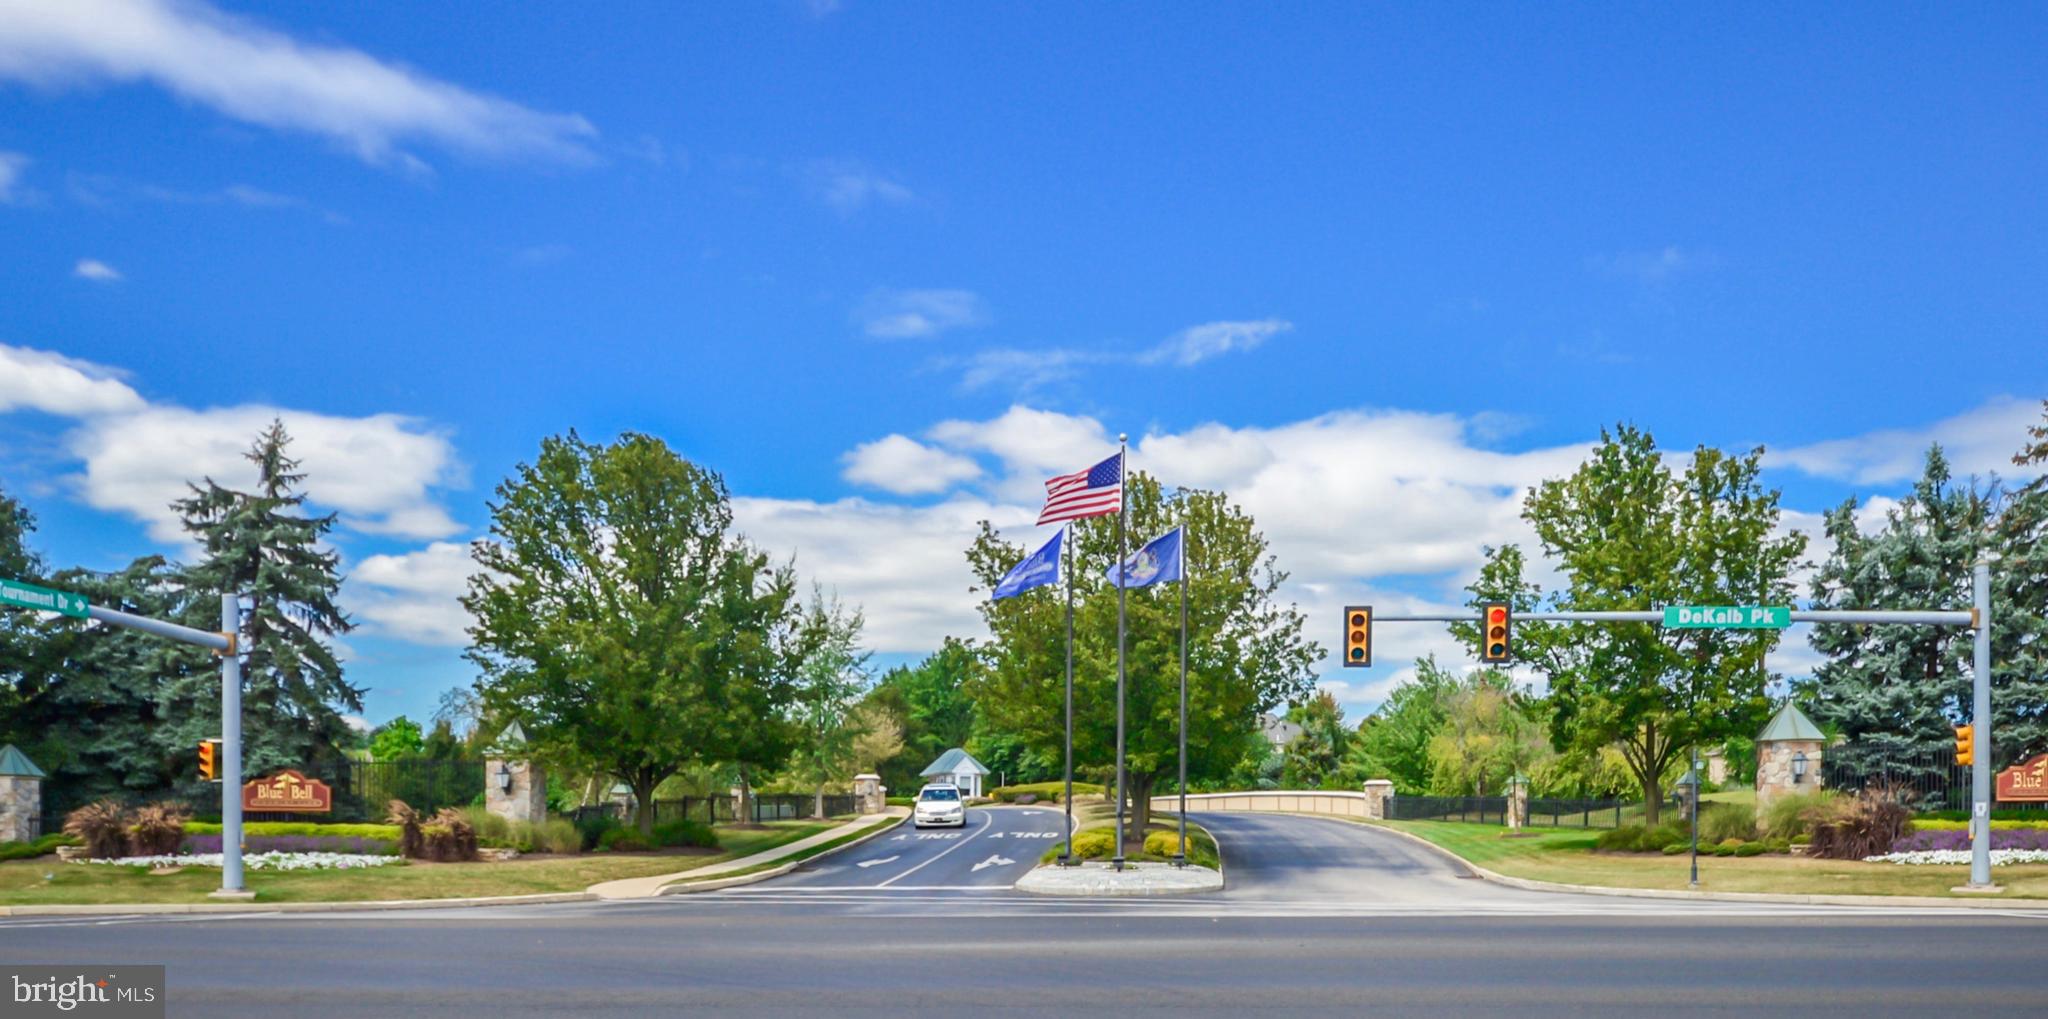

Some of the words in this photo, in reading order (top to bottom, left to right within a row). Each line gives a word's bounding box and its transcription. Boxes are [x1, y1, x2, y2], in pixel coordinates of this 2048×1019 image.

[0, 581, 54, 607] ournament
[57, 592, 68, 609] Dr
[1678, 608, 1743, 624] DeKalb
[1750, 608, 1774, 624] Pk
[2012, 771, 2042, 788] Blue
[257, 784, 283, 799] Blue
[291, 784, 313, 799] Bell
